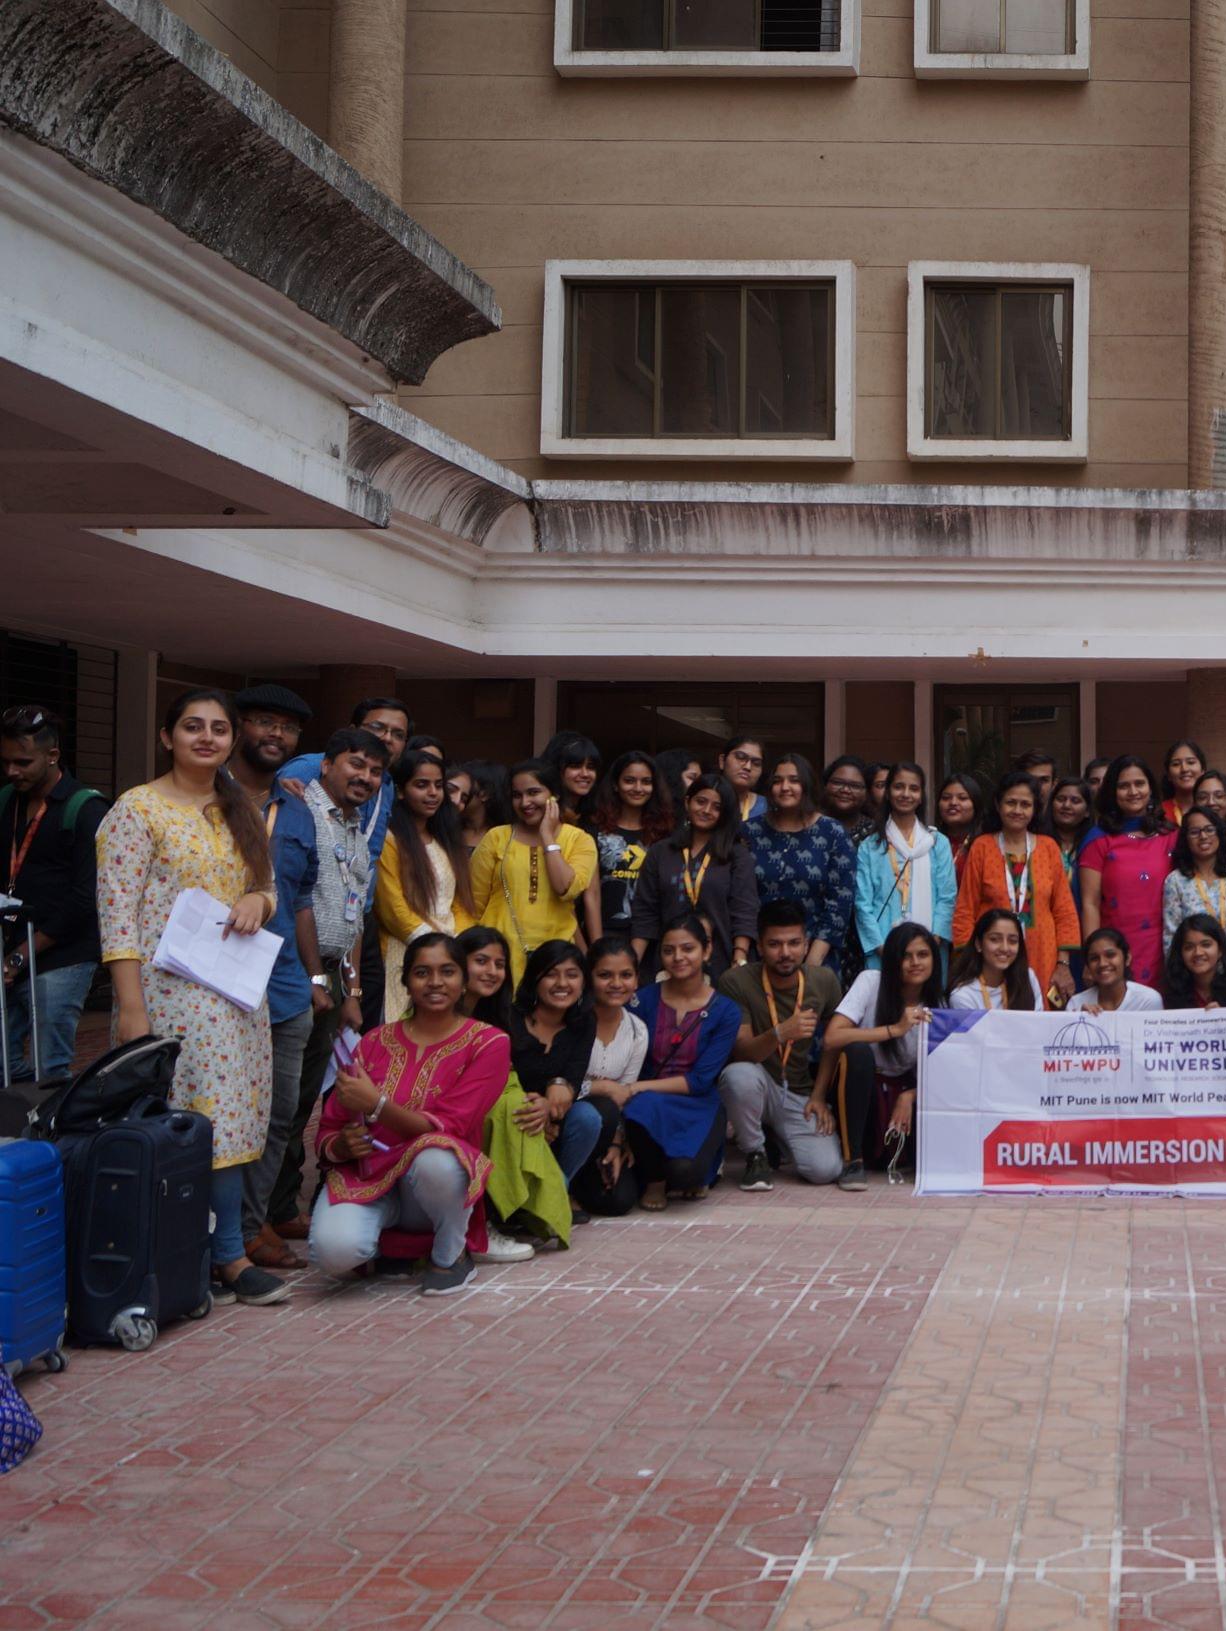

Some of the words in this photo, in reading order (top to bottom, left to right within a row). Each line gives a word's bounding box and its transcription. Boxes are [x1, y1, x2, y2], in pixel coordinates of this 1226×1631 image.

[1144, 1041, 1174, 1054] MIT
[1043, 1058, 1121, 1072] MIT-WPU
[1040, 1096, 1063, 1106] MIT
[1067, 1095, 1097, 1106] Pune
[1100, 1093, 1111, 1105] is
[1114, 1095, 1139, 1104] now
[1142, 1092, 1166, 1103] MIT
[1169, 1091, 1204, 1103] World
[997, 1142, 1078, 1167] RURAL
[1085, 1138, 1224, 1165] IMMERSION
